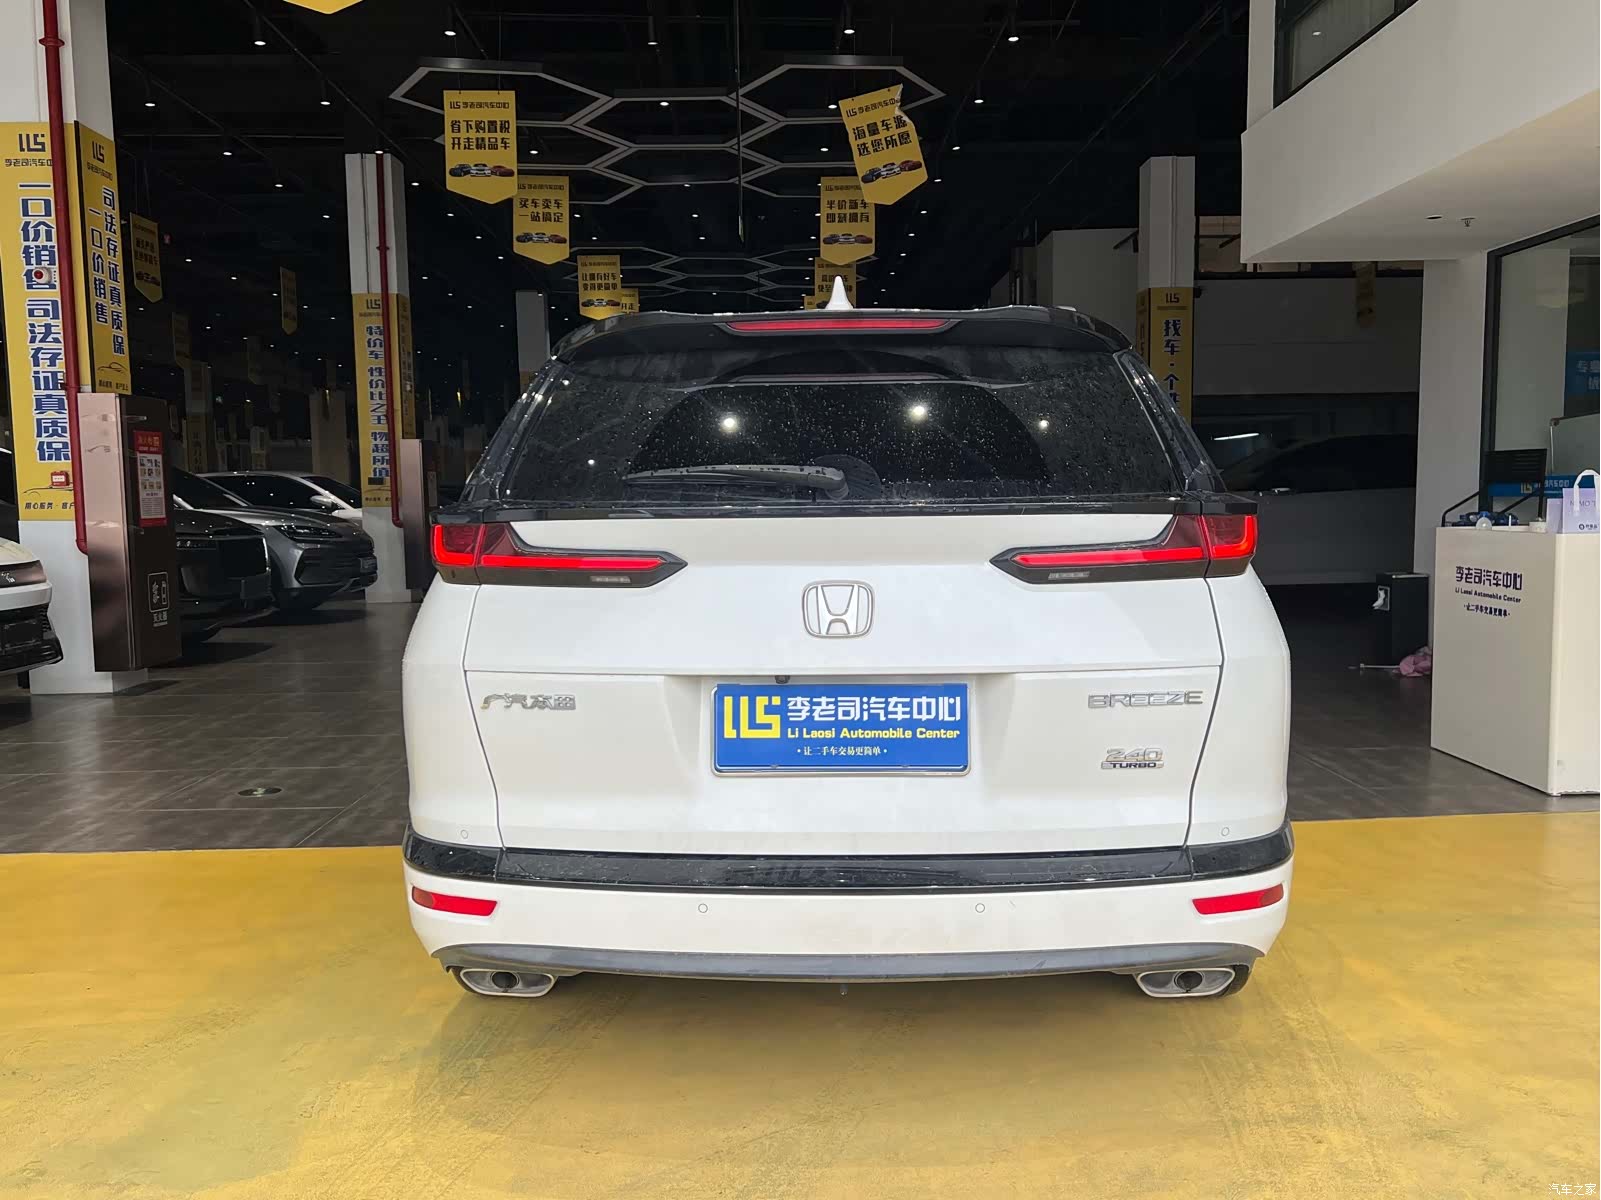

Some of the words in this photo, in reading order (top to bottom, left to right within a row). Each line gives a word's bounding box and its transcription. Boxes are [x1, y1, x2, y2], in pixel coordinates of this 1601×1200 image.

[450, 120, 511, 134] 省下购置税
[852, 115, 908, 141] 海量车源
[450, 137, 511, 151] 开走精品车
[857, 131, 912, 157] 选您所愿
[519, 198, 563, 209] 买车卖车
[826, 199, 869, 210] 半价新车
[519, 211, 564, 222] 一站搞定
[826, 212, 870, 223] 即刻拥有
[88, 207, 109, 324] 一口价销售
[102, 187, 126, 356] 司法存证真质保
[1455, 566, 1523, 591] 李老司汽车中心
[1474, 590, 1502, 600] Automobile
[1503, 594, 1522, 603] Center
[480, 693, 577, 710] 广汽本田
[1087, 691, 1204, 709] BREEZE
[787, 696, 961, 721] 李老司汽车中心
[787, 728, 800, 738] Li
[803, 728, 835, 739] Laosi
[840, 728, 912, 739] Automobile
[916, 728, 960, 739] Center
[1106, 748, 1164, 762] 240
